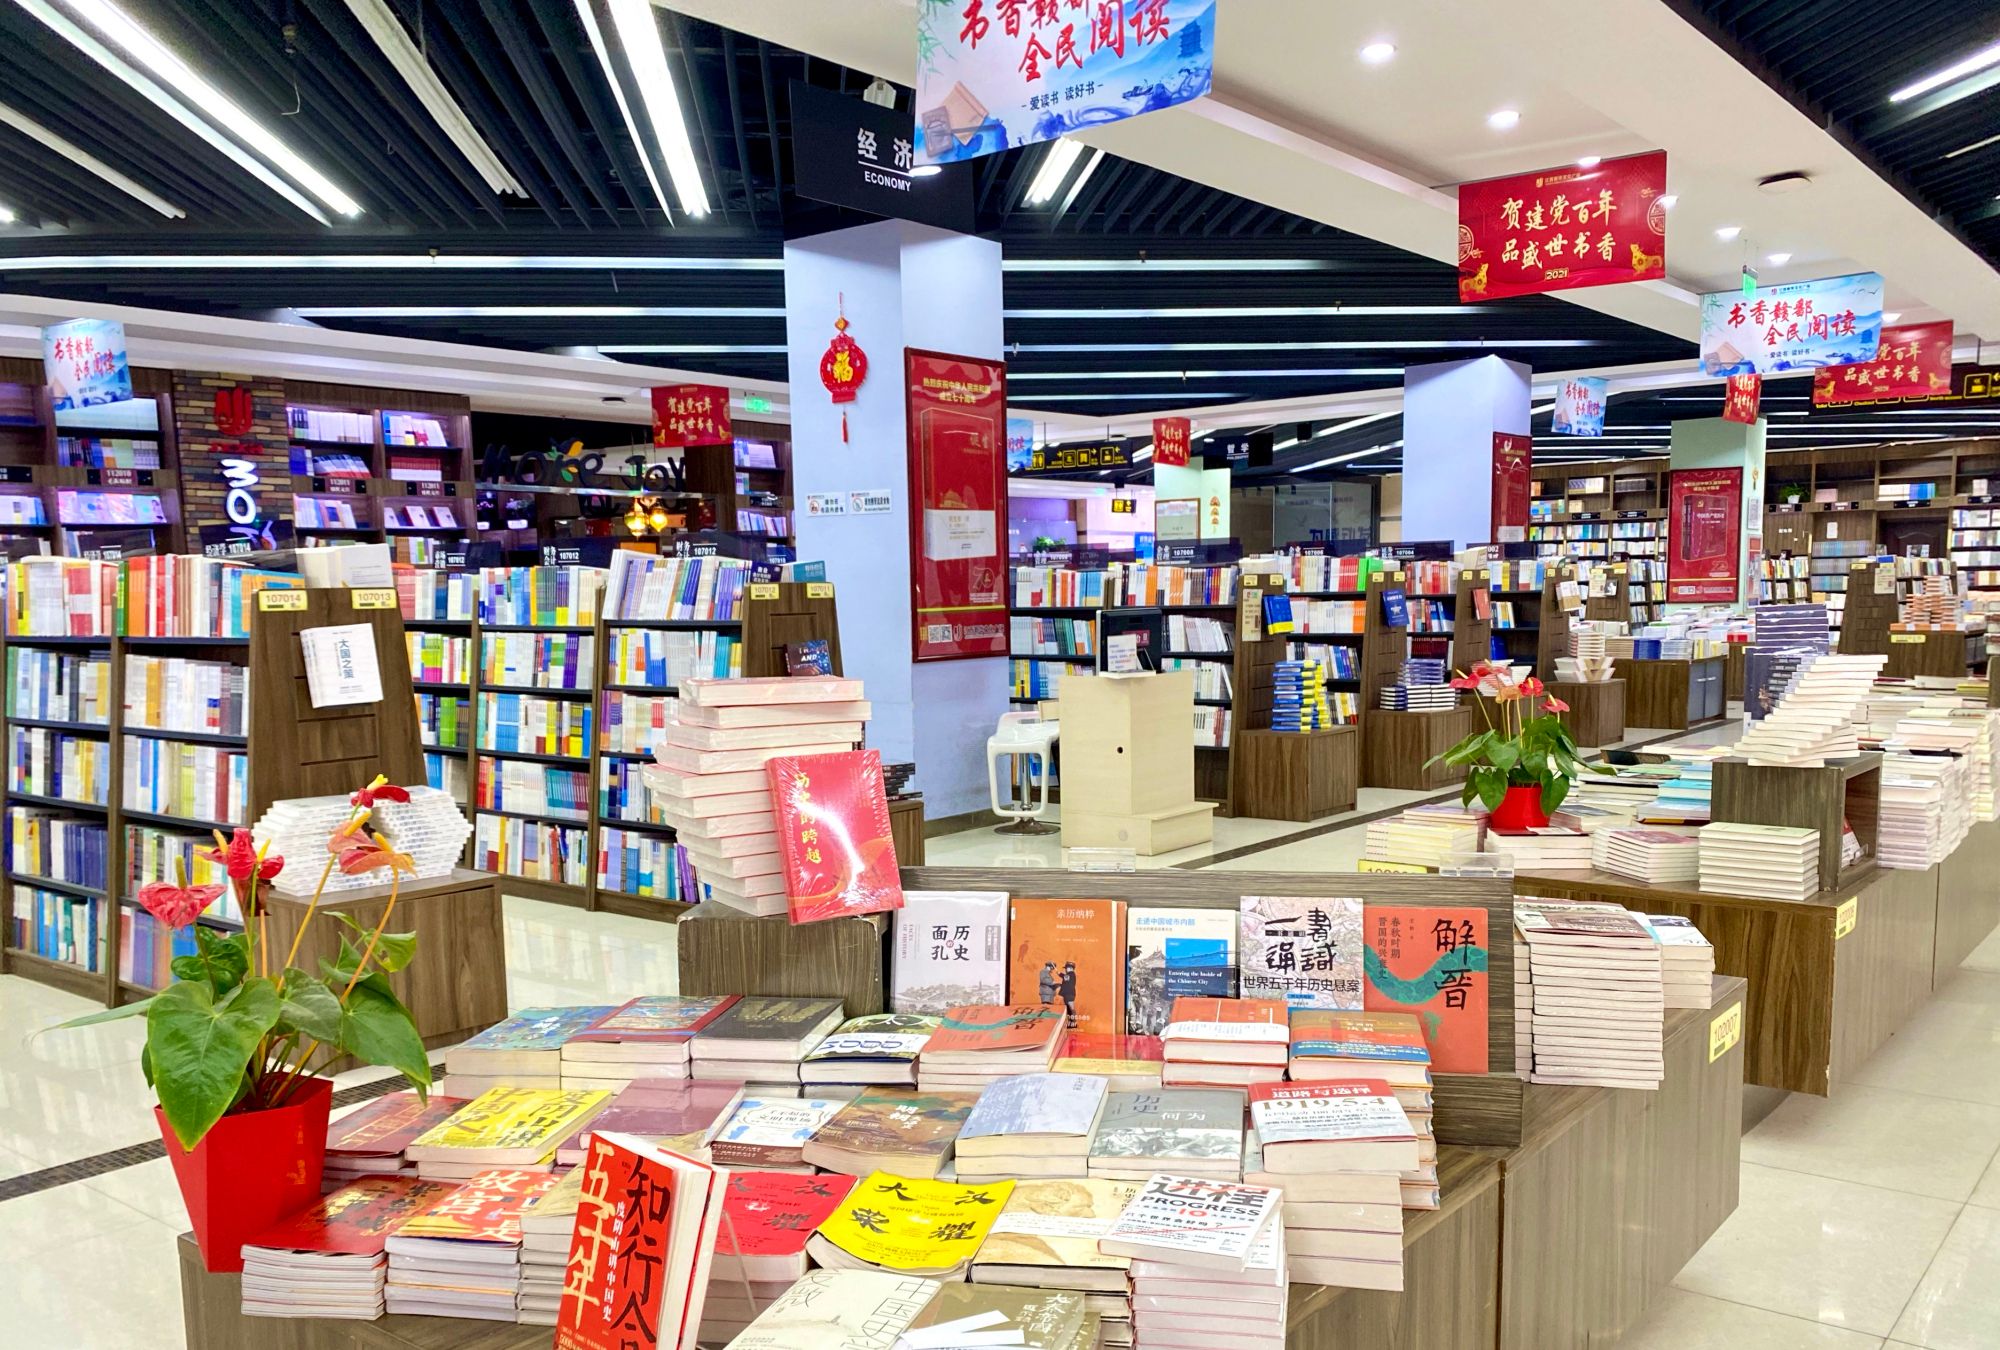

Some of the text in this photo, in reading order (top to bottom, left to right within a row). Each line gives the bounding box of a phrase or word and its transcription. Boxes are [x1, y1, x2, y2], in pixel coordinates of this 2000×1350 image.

[1018, 0, 1172, 82] 全民阅读
[1029, 81, 1096, 112] 爱读书 读好书
[857, 128, 913, 170] 经济
[864, 170, 912, 192] ECONOMY
[1500, 188, 1618, 232] 贺建党百年
[1501, 232, 1617, 270] 品盛世书香
[1546, 268, 1569, 280] 2021
[1763, 309, 1857, 346] 全民阅读
[1844, 365, 1921, 386] 品盛世书香
[559, 552, 580, 560] 107012
[694, 547, 717, 555] 107012
[265, 593, 301, 603] 107014
[358, 592, 391, 602] 107013
[1390, 917, 1401, 960] 春秋时期
[1168, 970, 1190, 979] Entering
[1243, 977, 1360, 993] 世界五千年历史悬案
[1715, 1013, 1738, 1043] 102007
[1262, 1097, 1387, 1111] 1919.5.4
[1161, 1111, 1207, 1121] 何为
[1146, 1176, 1270, 1209] 进程
[1140, 1195, 1262, 1217] PROGRESS
[1178, 1208, 1208, 1218] 10
[562, 1141, 615, 1330] 五千年
